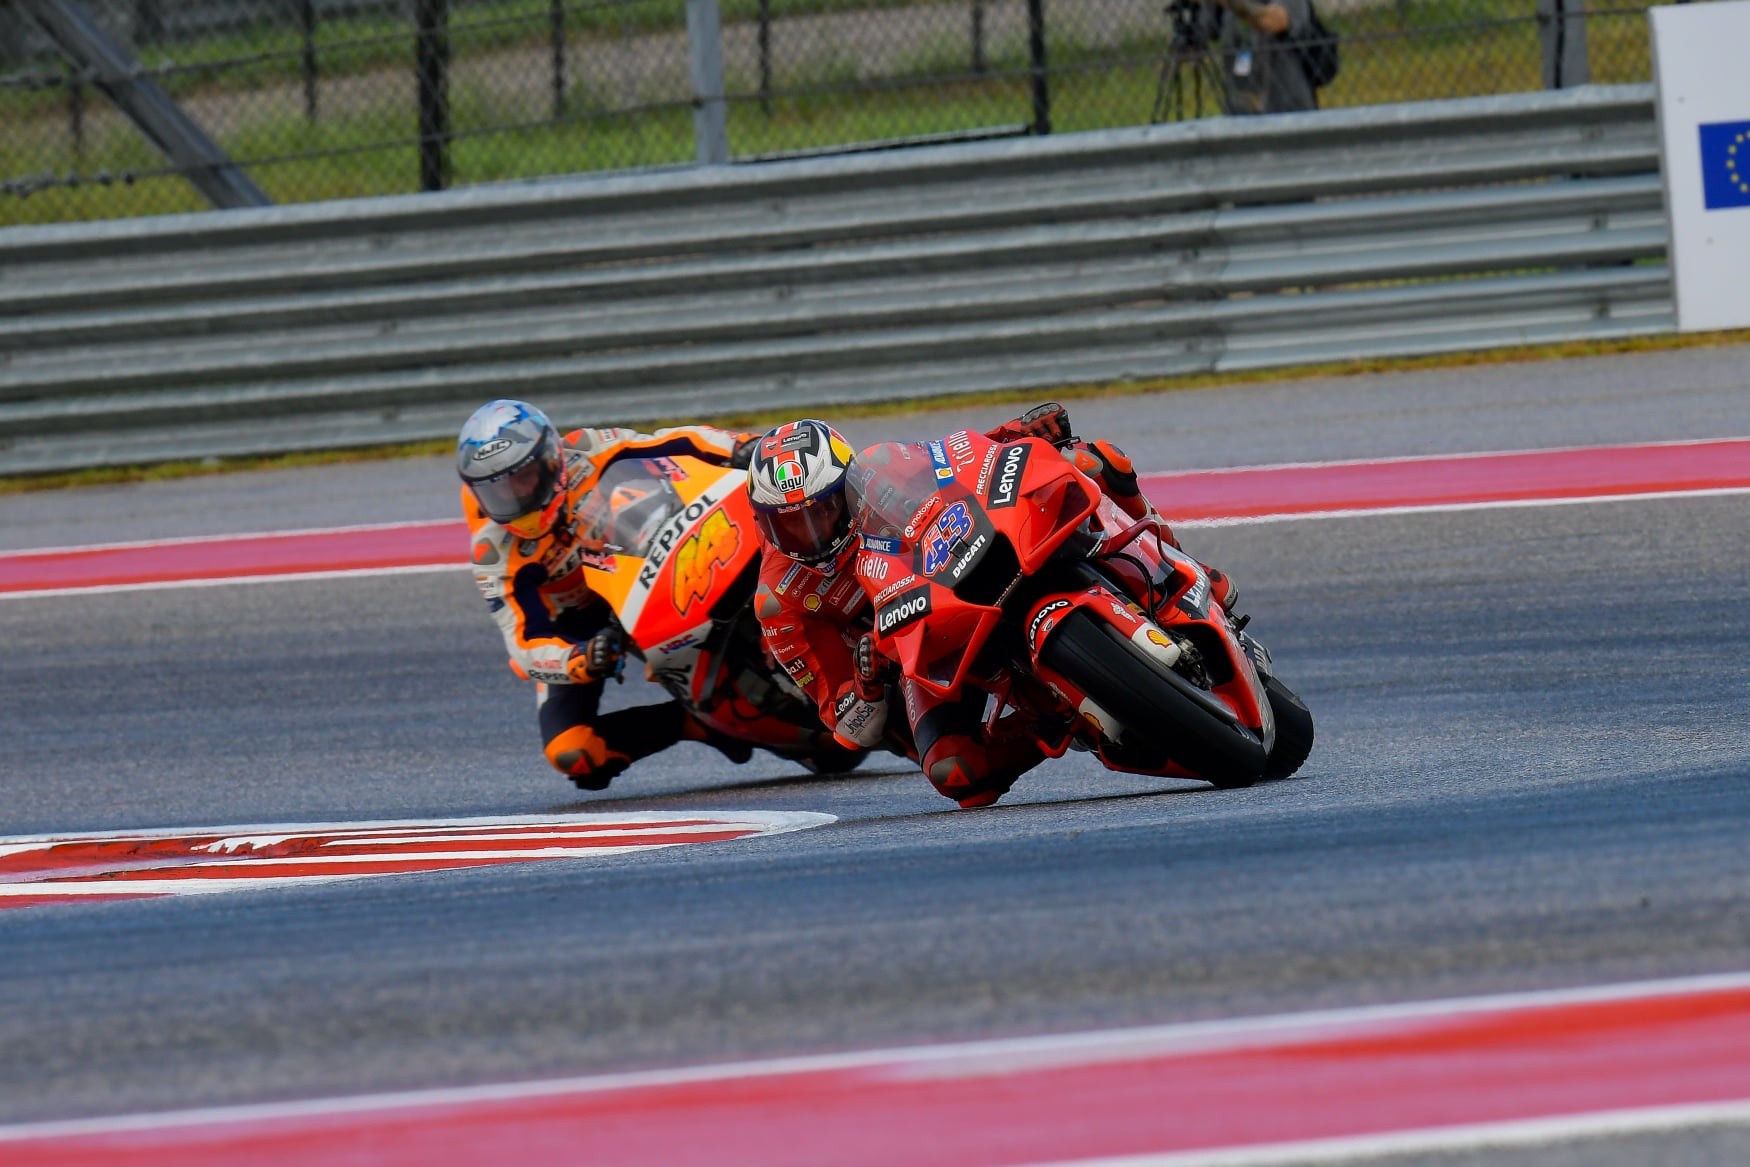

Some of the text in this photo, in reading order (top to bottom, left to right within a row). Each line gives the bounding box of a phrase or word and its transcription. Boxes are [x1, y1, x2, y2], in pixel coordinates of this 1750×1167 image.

[477, 440, 506, 458] HJC
[993, 446, 1024, 505] Lenovo
[639, 494, 718, 590] REPSOL
[673, 507, 740, 617] 44
[866, 538, 892, 552] ADVANCE
[922, 500, 975, 577] 43
[952, 534, 986, 578] DUCATI
[880, 596, 927, 632] Lenovo
